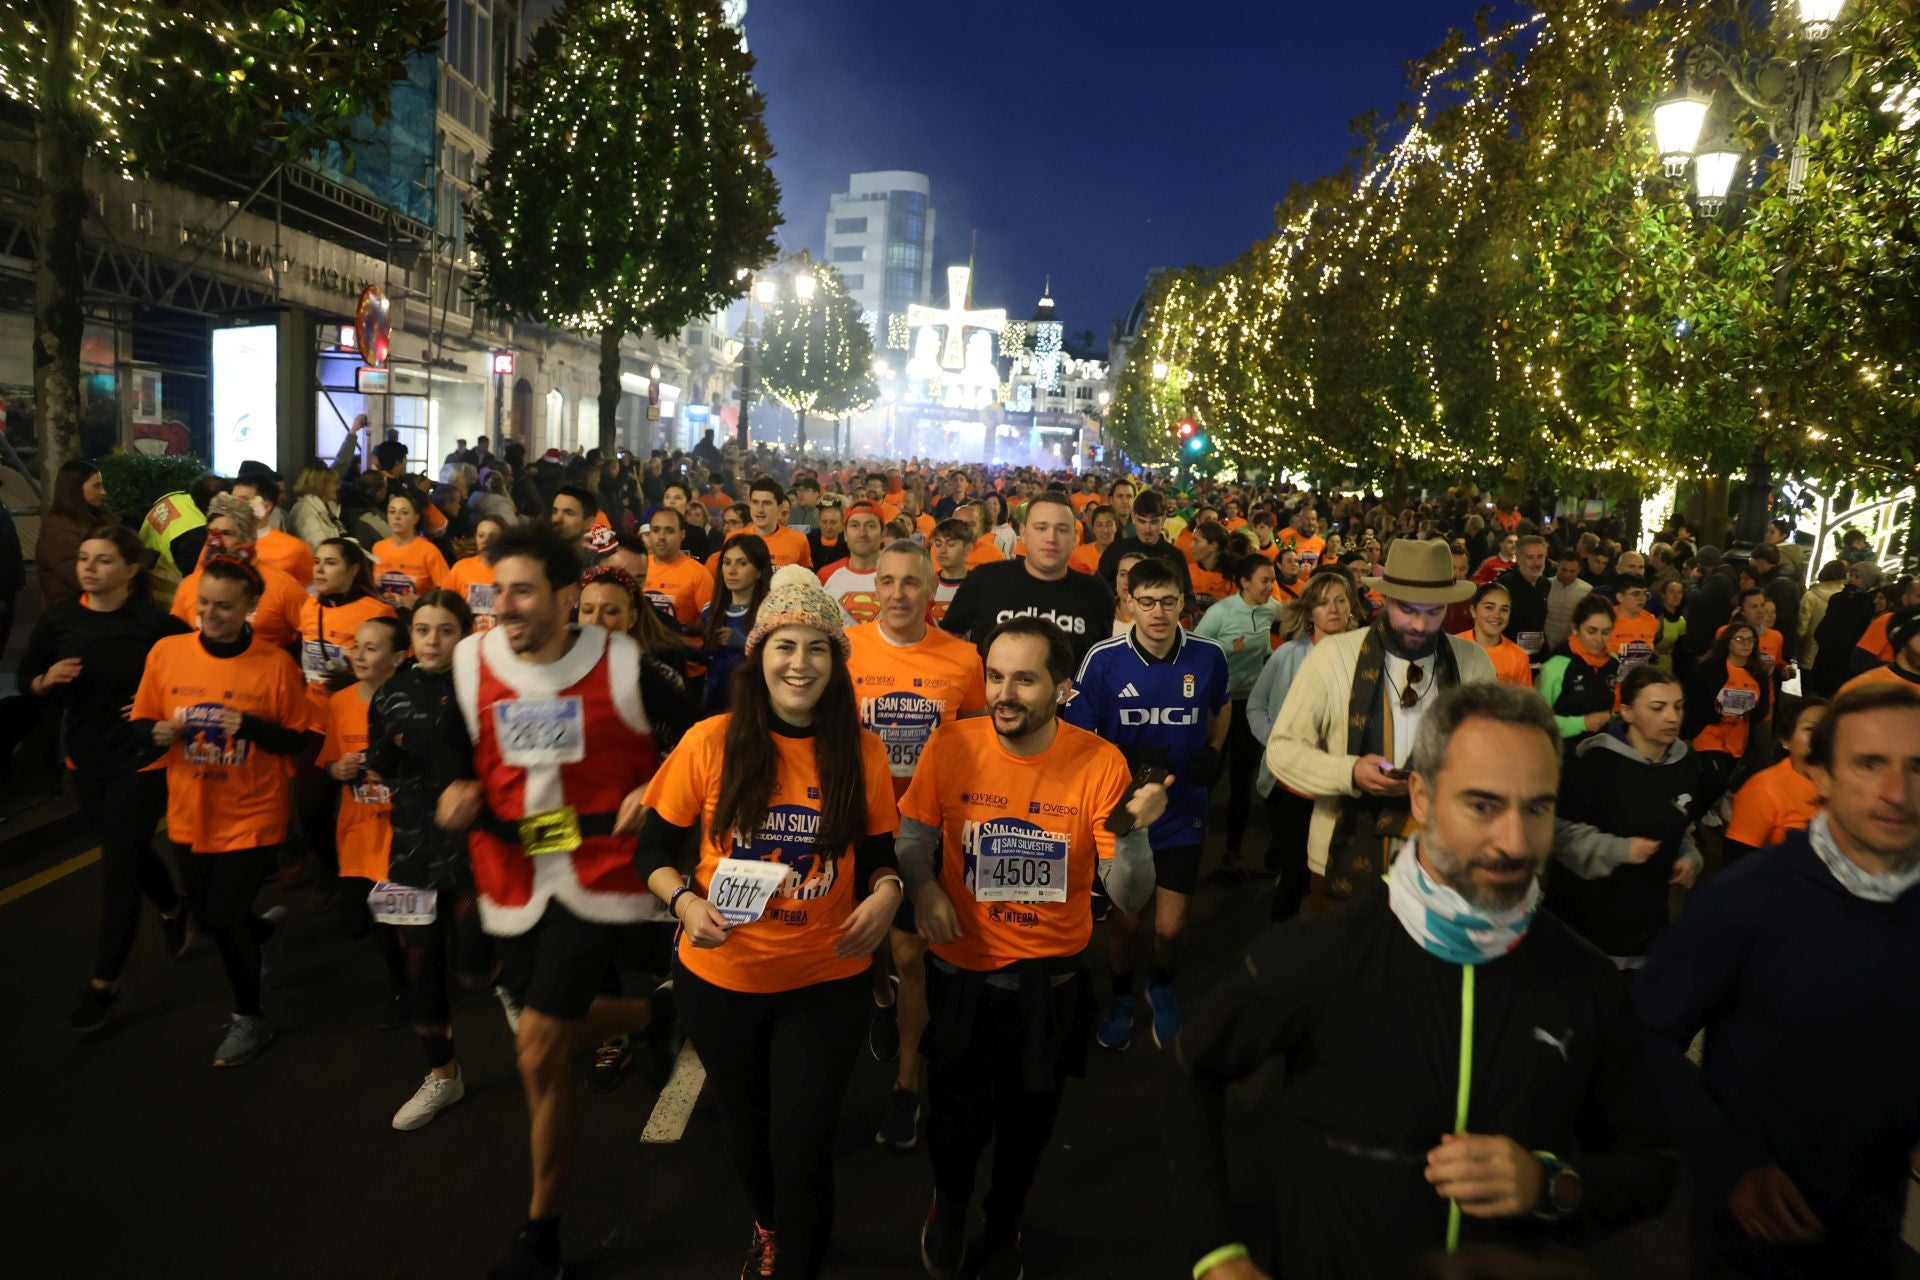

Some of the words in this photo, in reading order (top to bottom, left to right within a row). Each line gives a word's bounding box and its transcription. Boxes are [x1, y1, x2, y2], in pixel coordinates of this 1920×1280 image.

[861, 697, 876, 725] 41
[877, 697, 898, 711] SAN
[900, 698, 946, 713] SILVESTRE
[1119, 707, 1199, 726] DIGI
[971, 792, 1008, 805] OVIEDO
[1042, 803, 1079, 816] OVIEDO
[962, 820, 981, 856] 41
[991, 838, 1001, 854] 41
[1001, 837, 1017, 848] SAN
[1017, 840, 1055, 853] SILVESTRE
[992, 857, 1051, 886] 4503
[716, 876, 762, 910] 4443
[385, 893, 416, 914] 970
[771, 908, 808, 922] INTEGRA
[1004, 911, 1039, 925] INTEGRA
